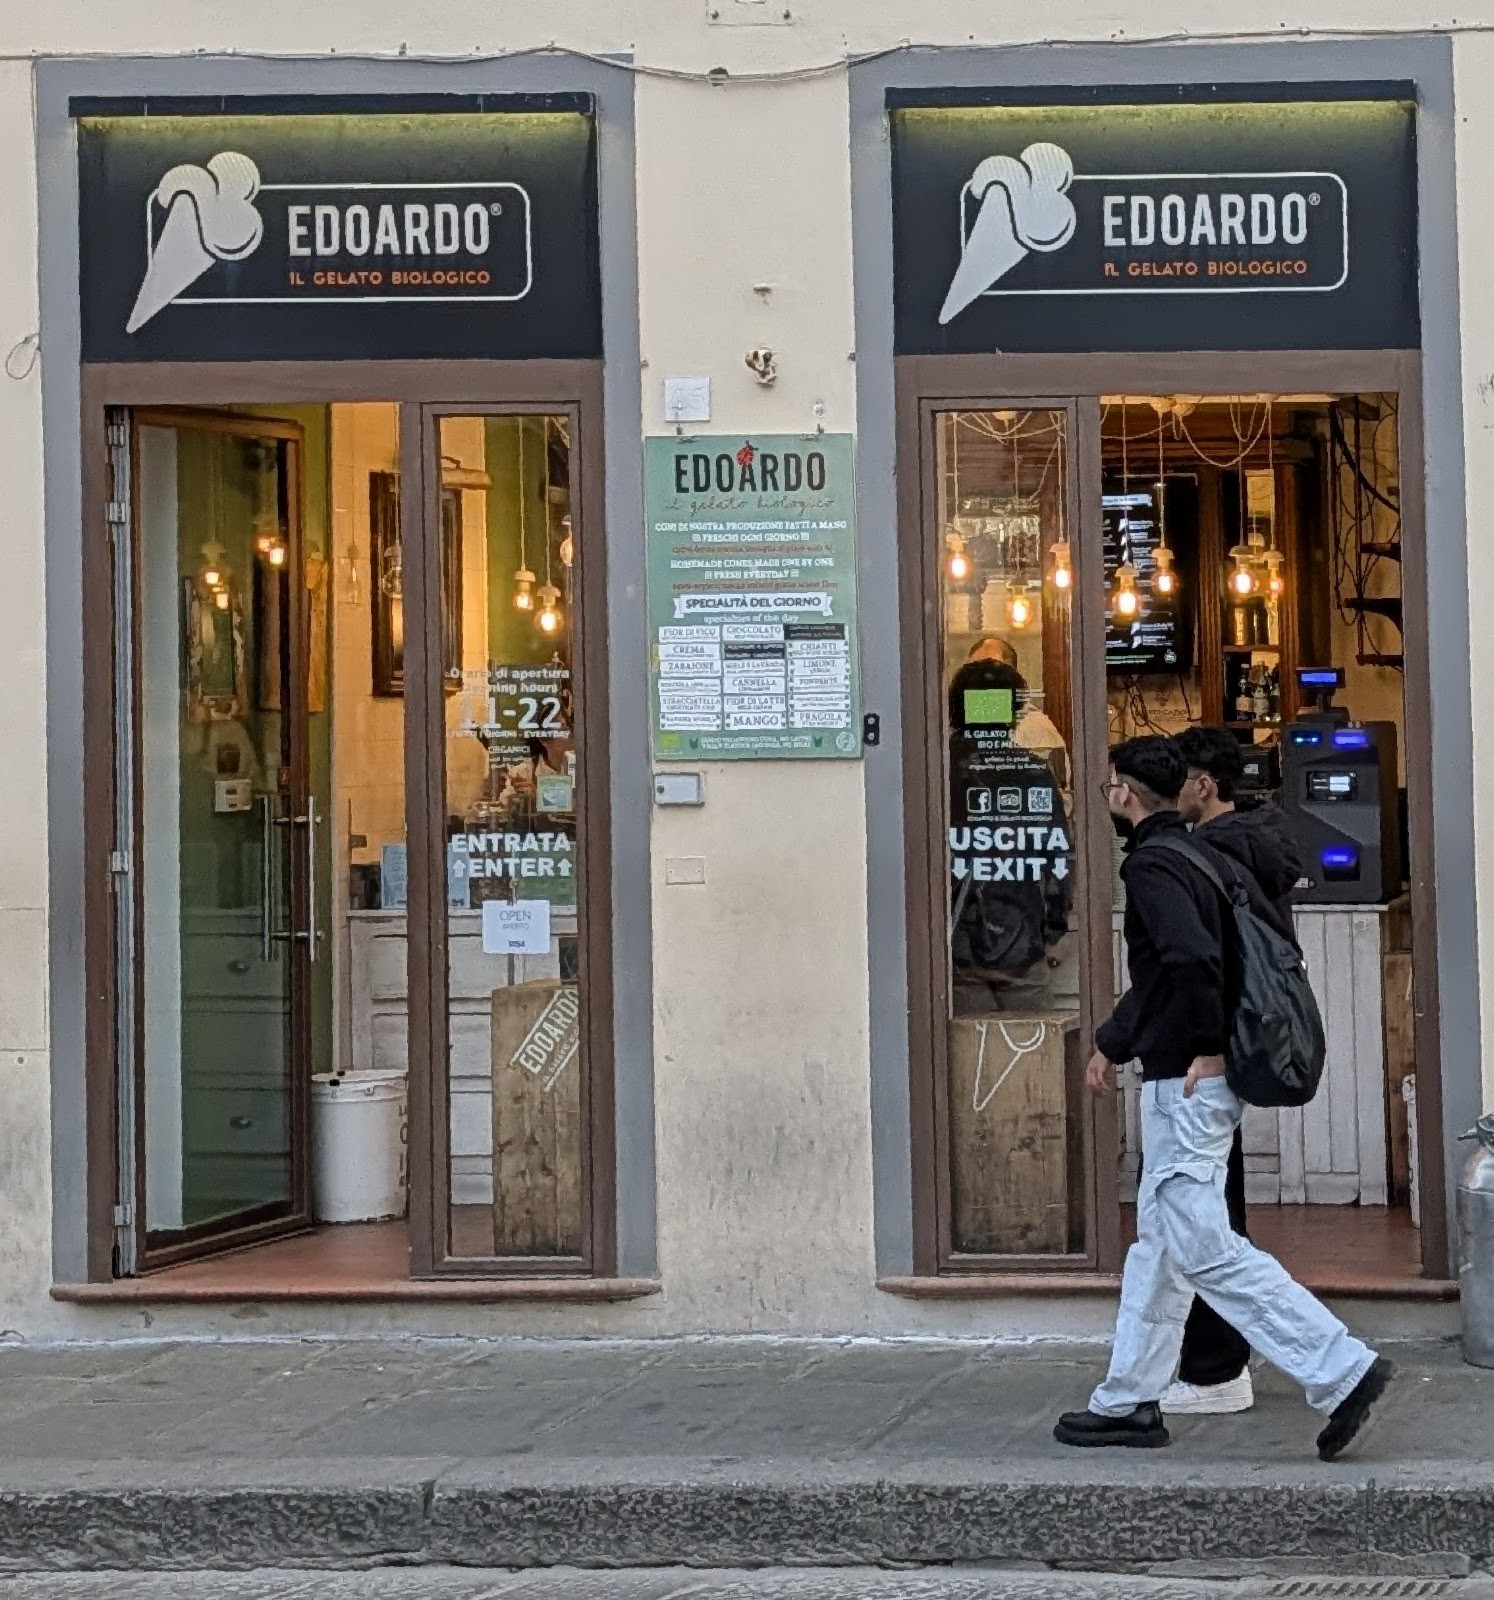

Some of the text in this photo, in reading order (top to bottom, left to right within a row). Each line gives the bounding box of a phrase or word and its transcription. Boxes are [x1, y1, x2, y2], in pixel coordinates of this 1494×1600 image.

[1103, 192, 1308, 248] EDOARDO
[288, 202, 490, 258] EDOARDO
[1104, 260, 1308, 276] IL GELATO BIOLOGICO
[290, 270, 490, 286] IL GELATO BIOLOGICO
[674, 452, 826, 493] EDOARDO
[750, 597, 772, 607] DEL
[774, 596, 821, 607] GIORNO
[496, 667, 507, 678] di
[511, 669, 569, 680] apertura
[521, 683, 558, 693] hours
[733, 715, 778, 726] MANGO
[974, 730, 1007, 738] GELATO
[452, 832, 571, 852] ENTRATA
[949, 827, 1069, 851] USCITA
[469, 858, 555, 877] ENTER
[973, 857, 1047, 881] EXIT
[499, 910, 532, 921] OPEN
[519, 988, 579, 1074] EDOARDO
